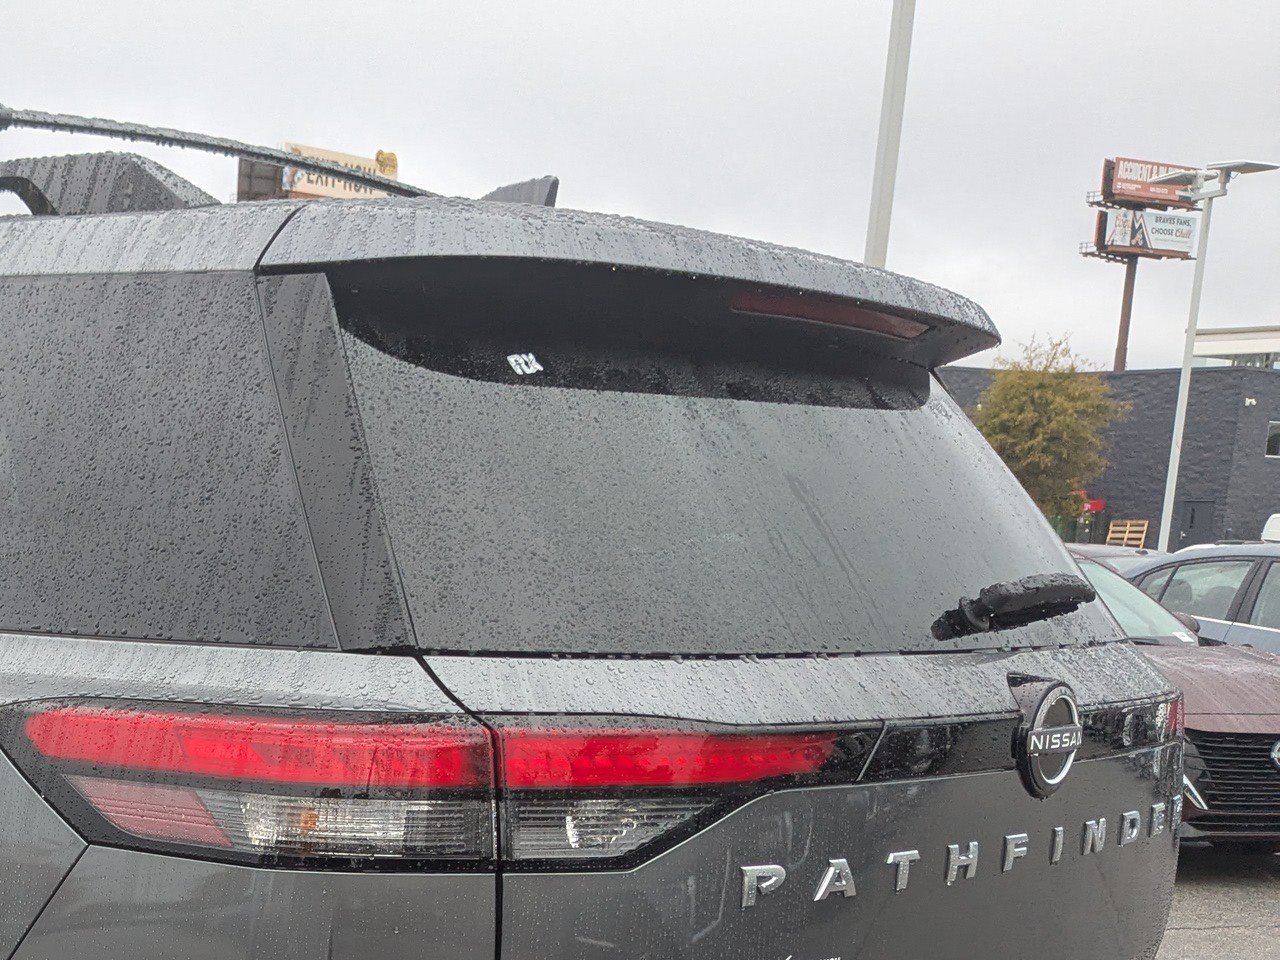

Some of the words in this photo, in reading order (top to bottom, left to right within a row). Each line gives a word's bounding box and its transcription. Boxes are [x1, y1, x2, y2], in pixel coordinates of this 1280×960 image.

[1118, 160, 1152, 183] ACCIDENT
[1155, 215, 1176, 225] BRAVES
[1151, 227, 1174, 236] CHOOSE
[1030, 731, 1082, 750] NISSAN
